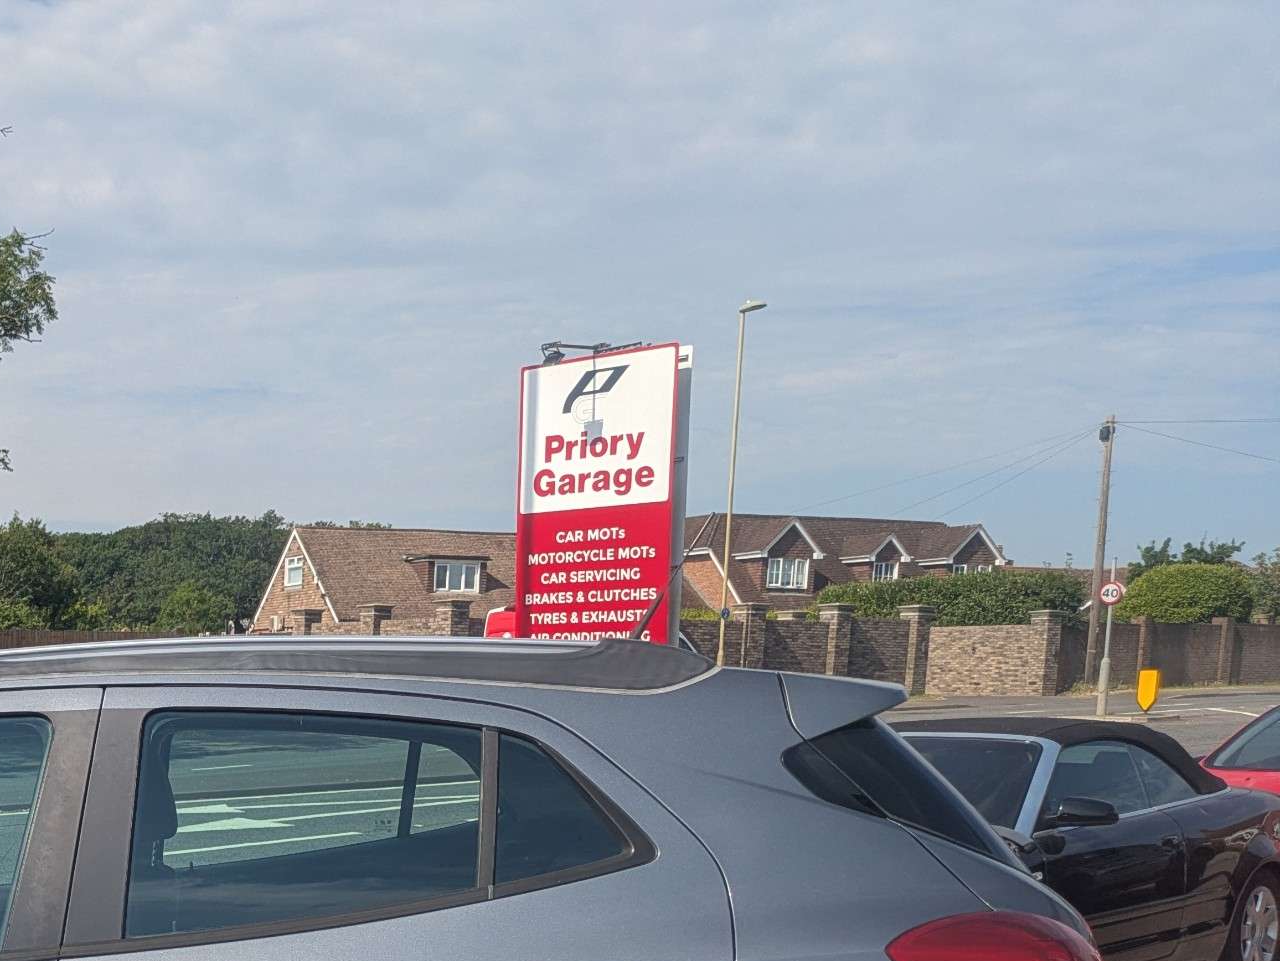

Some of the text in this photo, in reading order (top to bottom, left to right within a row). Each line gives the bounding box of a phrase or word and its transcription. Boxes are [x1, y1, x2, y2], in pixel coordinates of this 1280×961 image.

[544, 431, 645, 463] Priory
[533, 465, 655, 497] Garage
[555, 527, 625, 543] CAR MOTs
[528, 545, 656, 566] MOTORCYCLE MOTs
[540, 567, 641, 585] CAR SERVICING
[525, 587, 657, 605] BRAKES & CLUTCHES
[1103, 588, 1118, 598] 40
[530, 613, 567, 625] TYRES
[570, 611, 578, 624] &
[552, 630, 651, 642] CONDITIONIG
